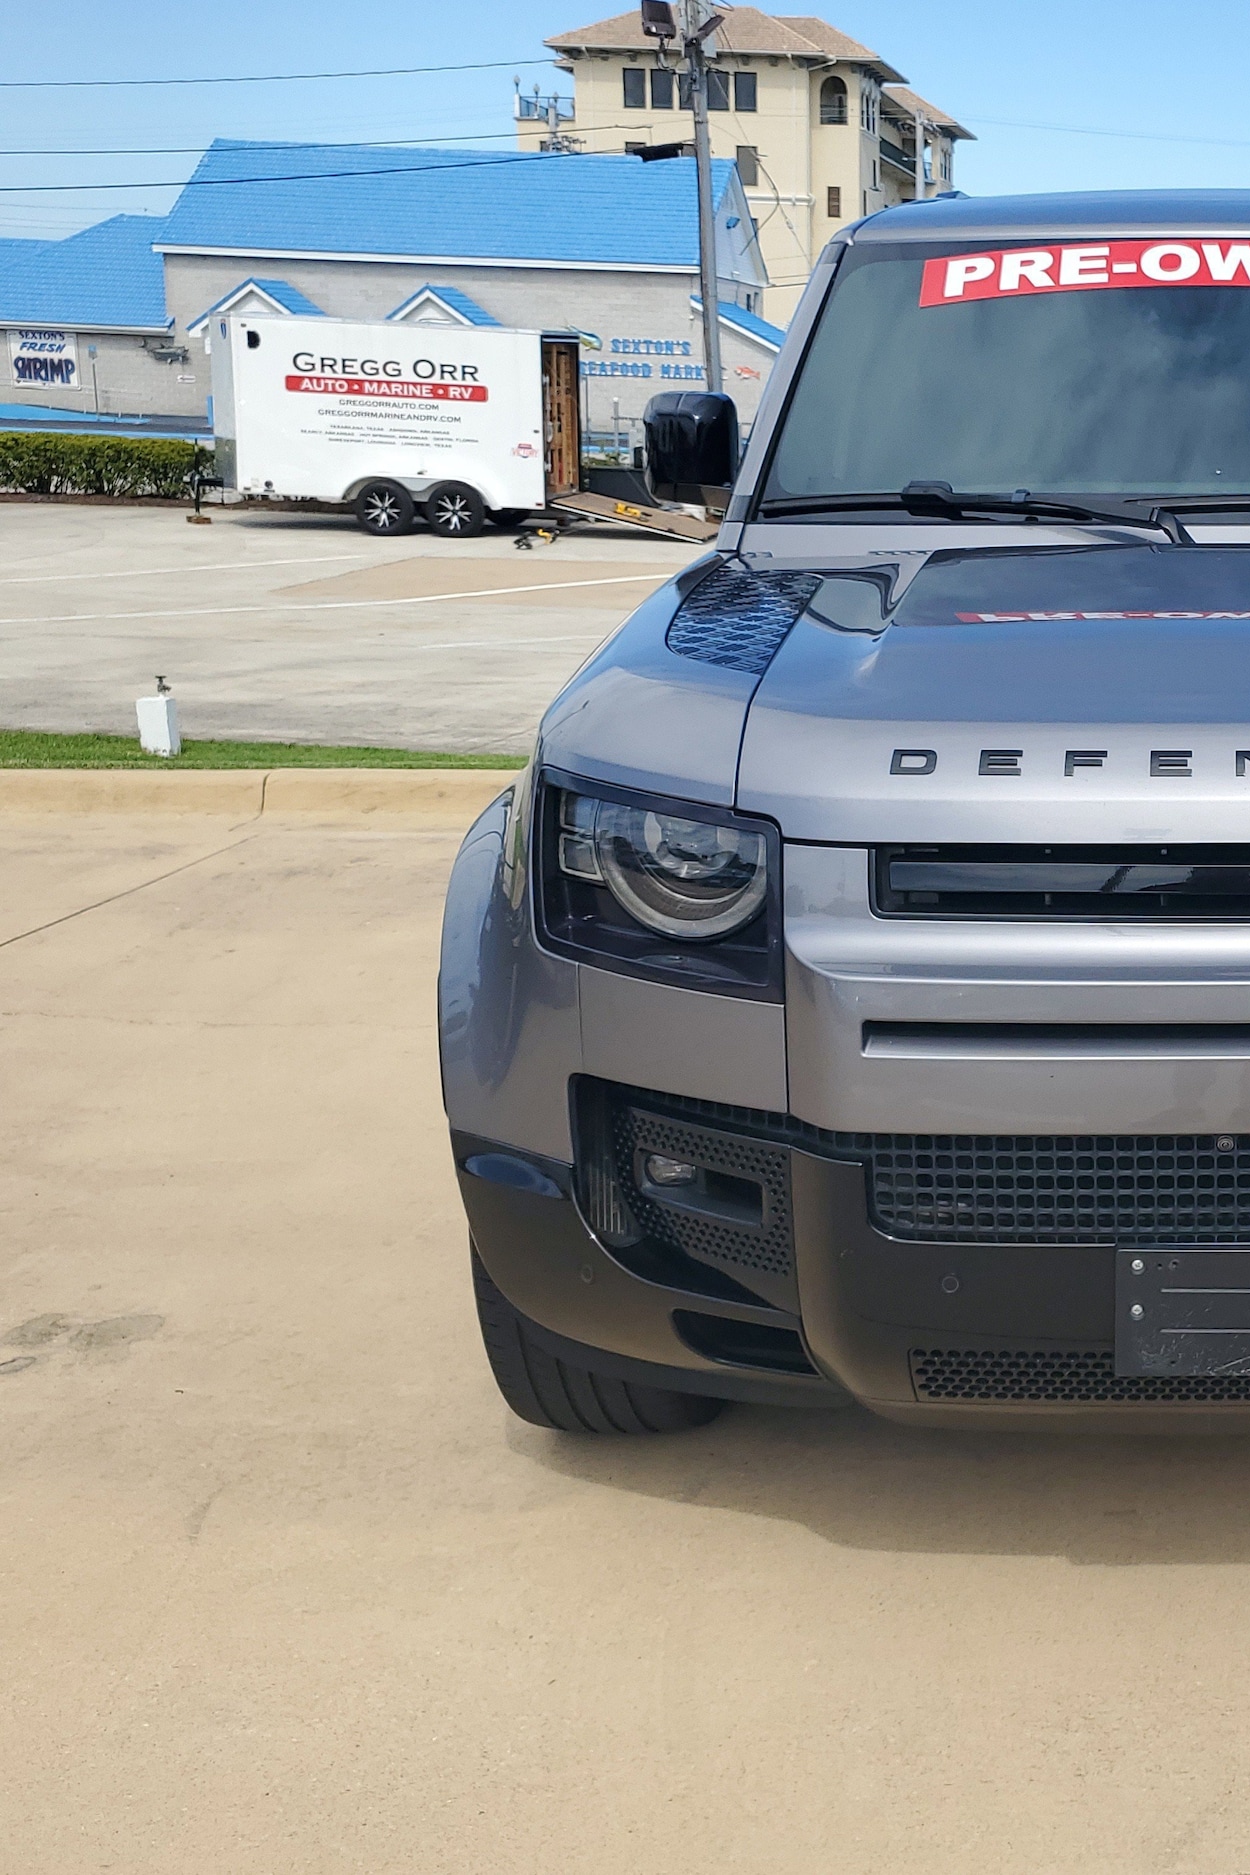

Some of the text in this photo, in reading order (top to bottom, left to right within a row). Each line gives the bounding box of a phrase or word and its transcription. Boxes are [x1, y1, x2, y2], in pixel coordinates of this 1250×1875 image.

[18, 330, 66, 341] SEXTON'S
[19, 341, 66, 354] FRESH
[610, 337, 692, 356] SEXTON'S
[13, 356, 76, 384] SHRIMP
[292, 352, 480, 382] GREGG ORR
[660, 364, 727, 380] MARK
[300, 377, 473, 399] AUTO MARINE RV
[338, 398, 440, 411] GREGGORRAUTO.COM
[317, 408, 462, 424] GREGGORRMARINEANDRV.COM
